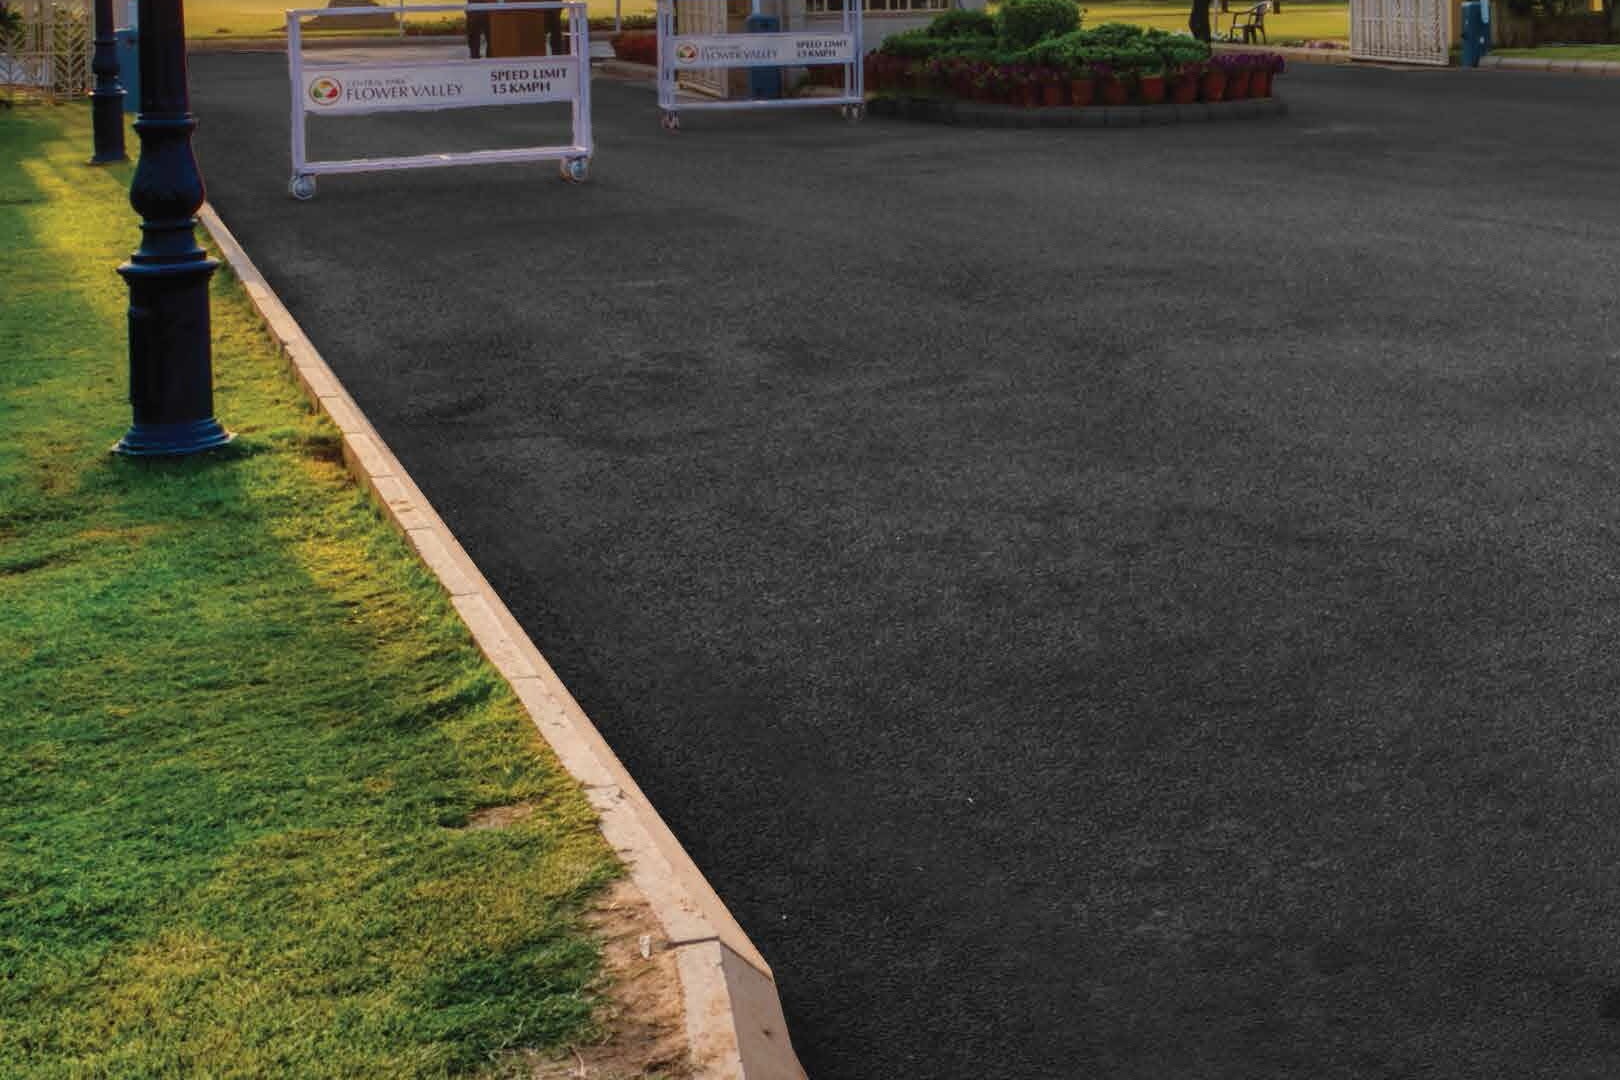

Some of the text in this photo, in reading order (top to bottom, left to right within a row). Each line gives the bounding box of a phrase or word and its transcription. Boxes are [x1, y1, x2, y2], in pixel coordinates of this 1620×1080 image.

[490, 68, 568, 80] SPEED LIMIT
[346, 83, 464, 101] FLOWER VALLEY
[491, 81, 551, 94] 15 KMPH
